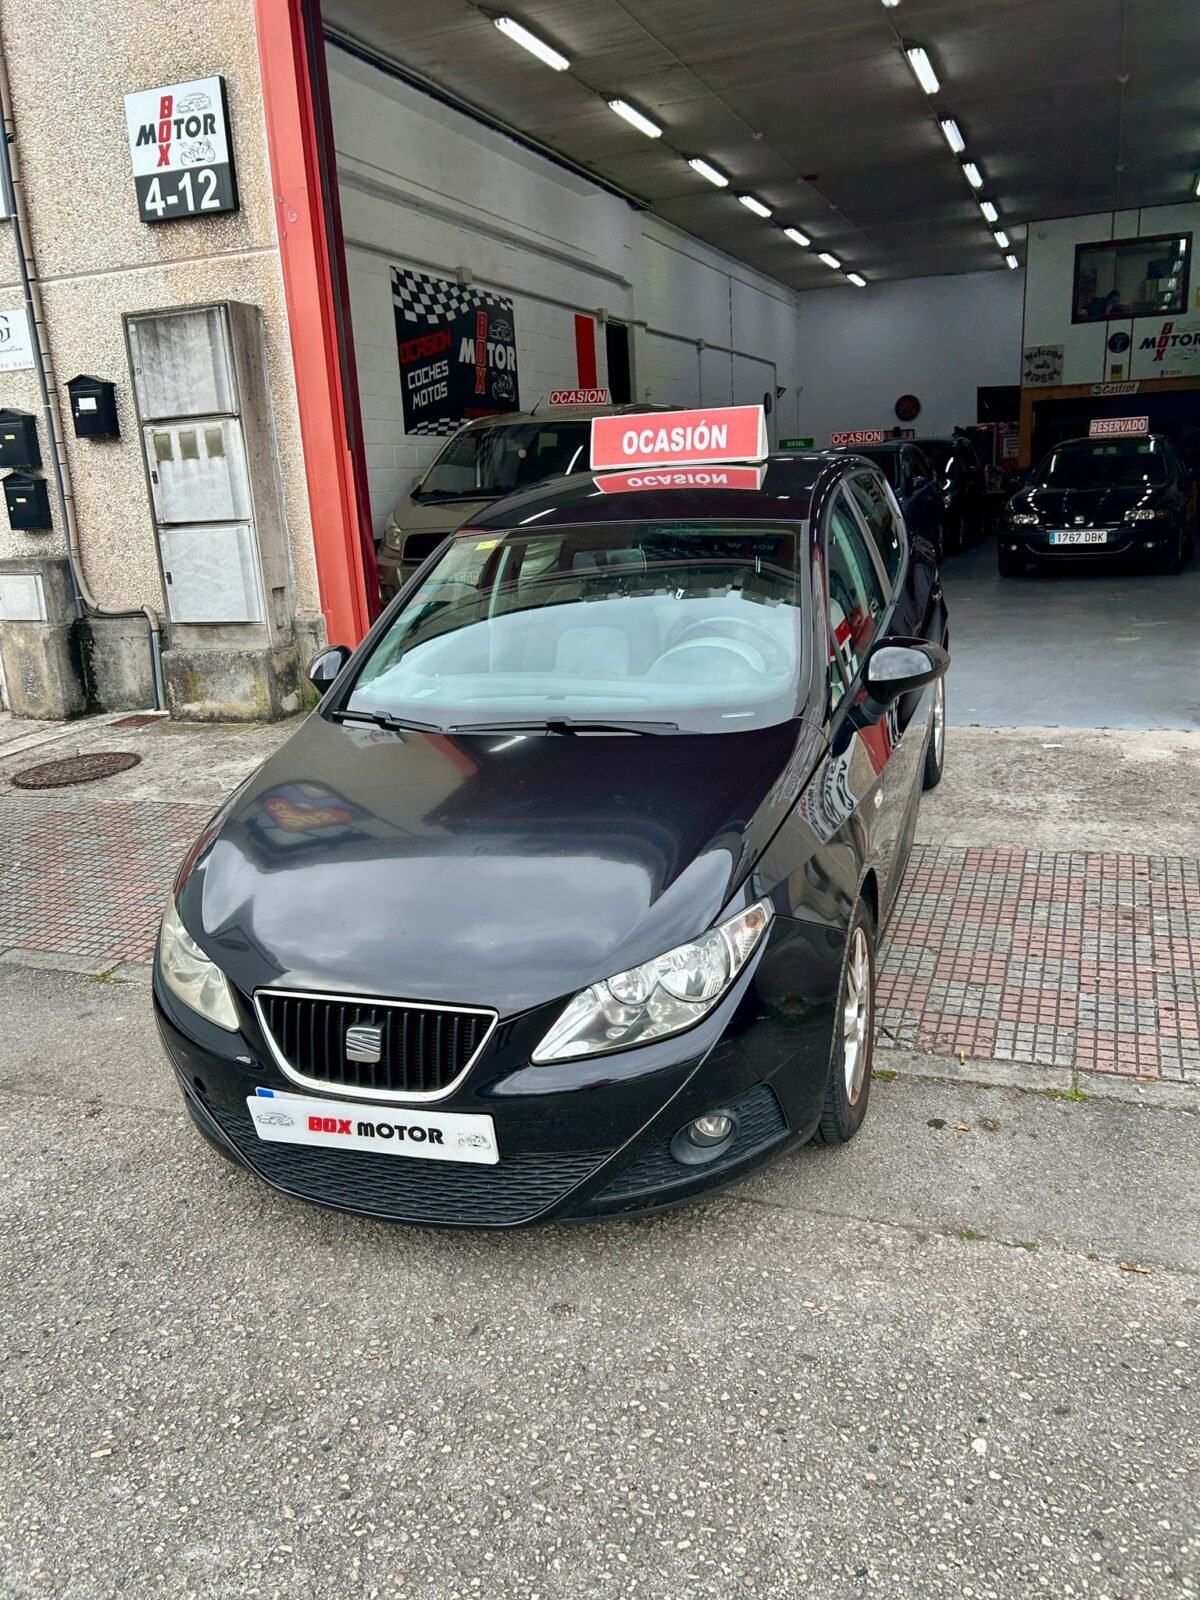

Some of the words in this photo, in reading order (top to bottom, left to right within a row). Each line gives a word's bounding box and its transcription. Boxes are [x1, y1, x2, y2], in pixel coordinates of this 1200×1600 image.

[157, 95, 173, 168] BOX
[145, 168, 221, 217] 4-12
[407, 359, 449, 389] COCHES
[412, 381, 448, 410] MOTOS
[1102, 383, 1137, 395] Castrol
[621, 420, 728, 455] OCASIÓN
[1091, 418, 1147, 434] RESERVADO
[1056, 531, 1082, 544] 1767
[1085, 530, 1105, 543] DBK
[309, 1116, 351, 1134] BOX
[357, 1122, 444, 1144] MOTOR
